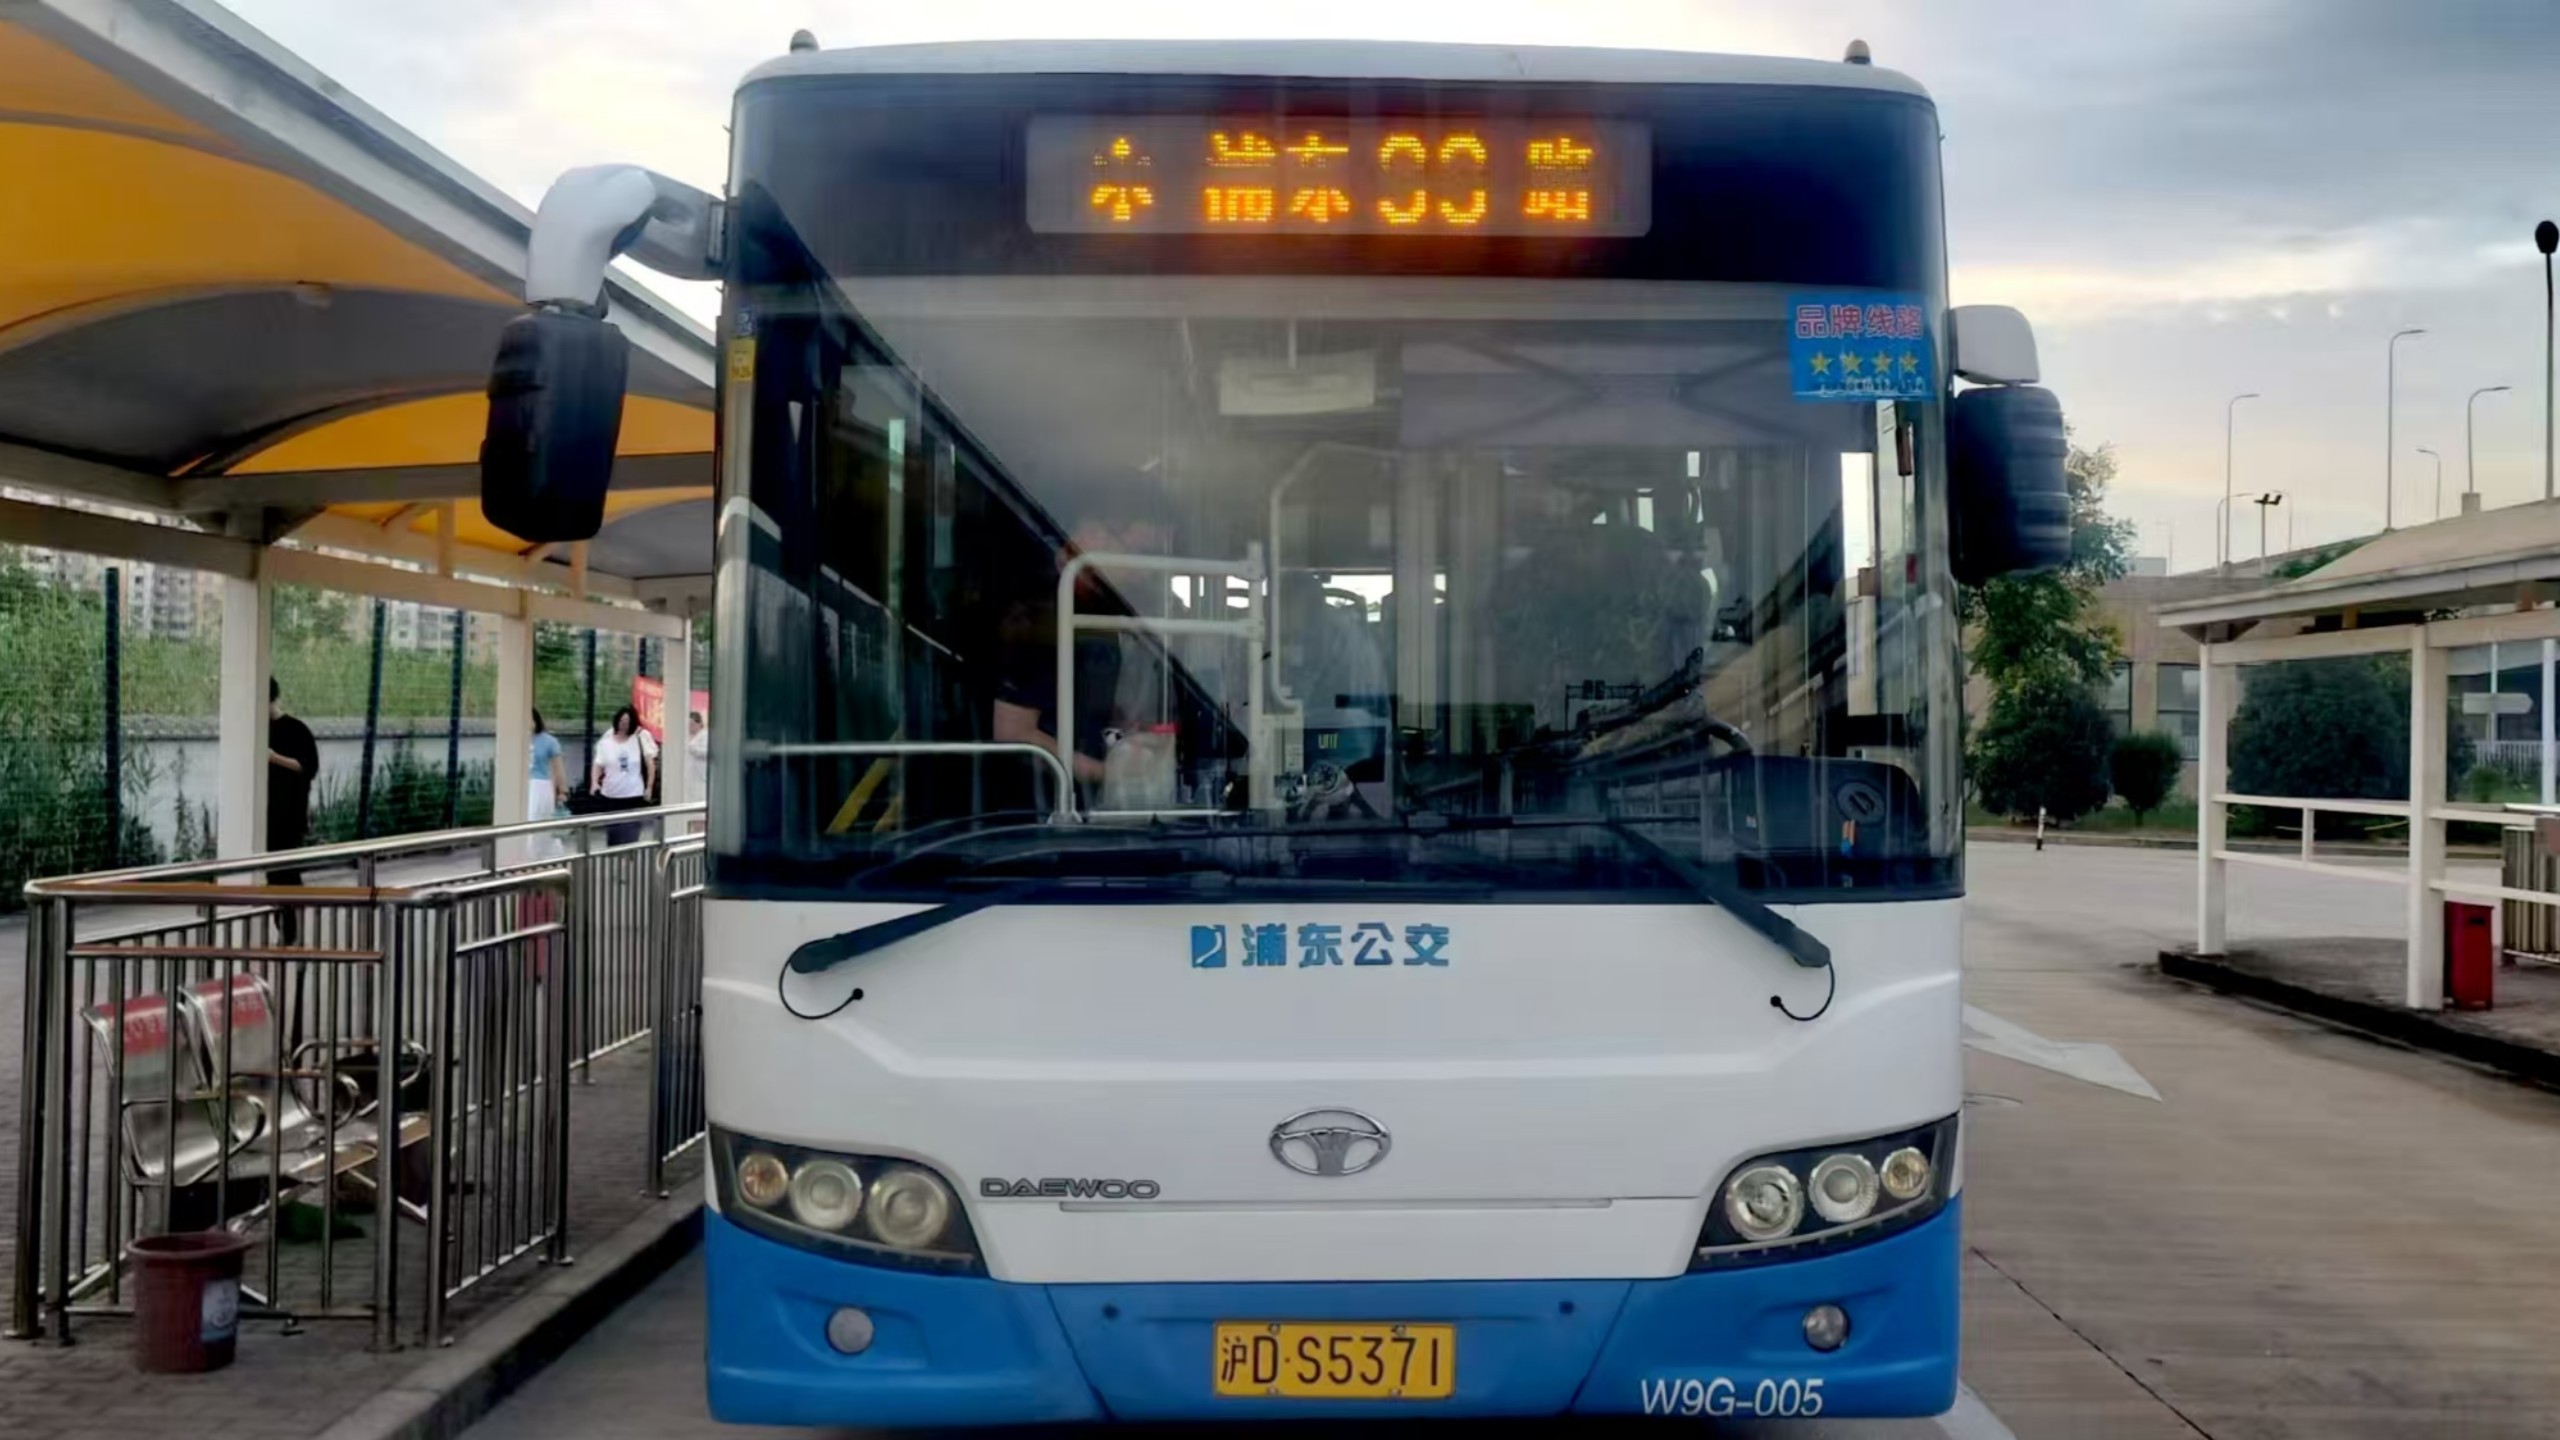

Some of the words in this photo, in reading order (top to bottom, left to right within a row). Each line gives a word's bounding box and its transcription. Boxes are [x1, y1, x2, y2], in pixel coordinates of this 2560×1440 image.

[1796, 303, 1923, 339] 品牌线路
[1241, 922, 1450, 968] 浦东公交
[980, 1177, 1161, 1199] DAEWOO
[1641, 1377, 1824, 1417] W9G-005
